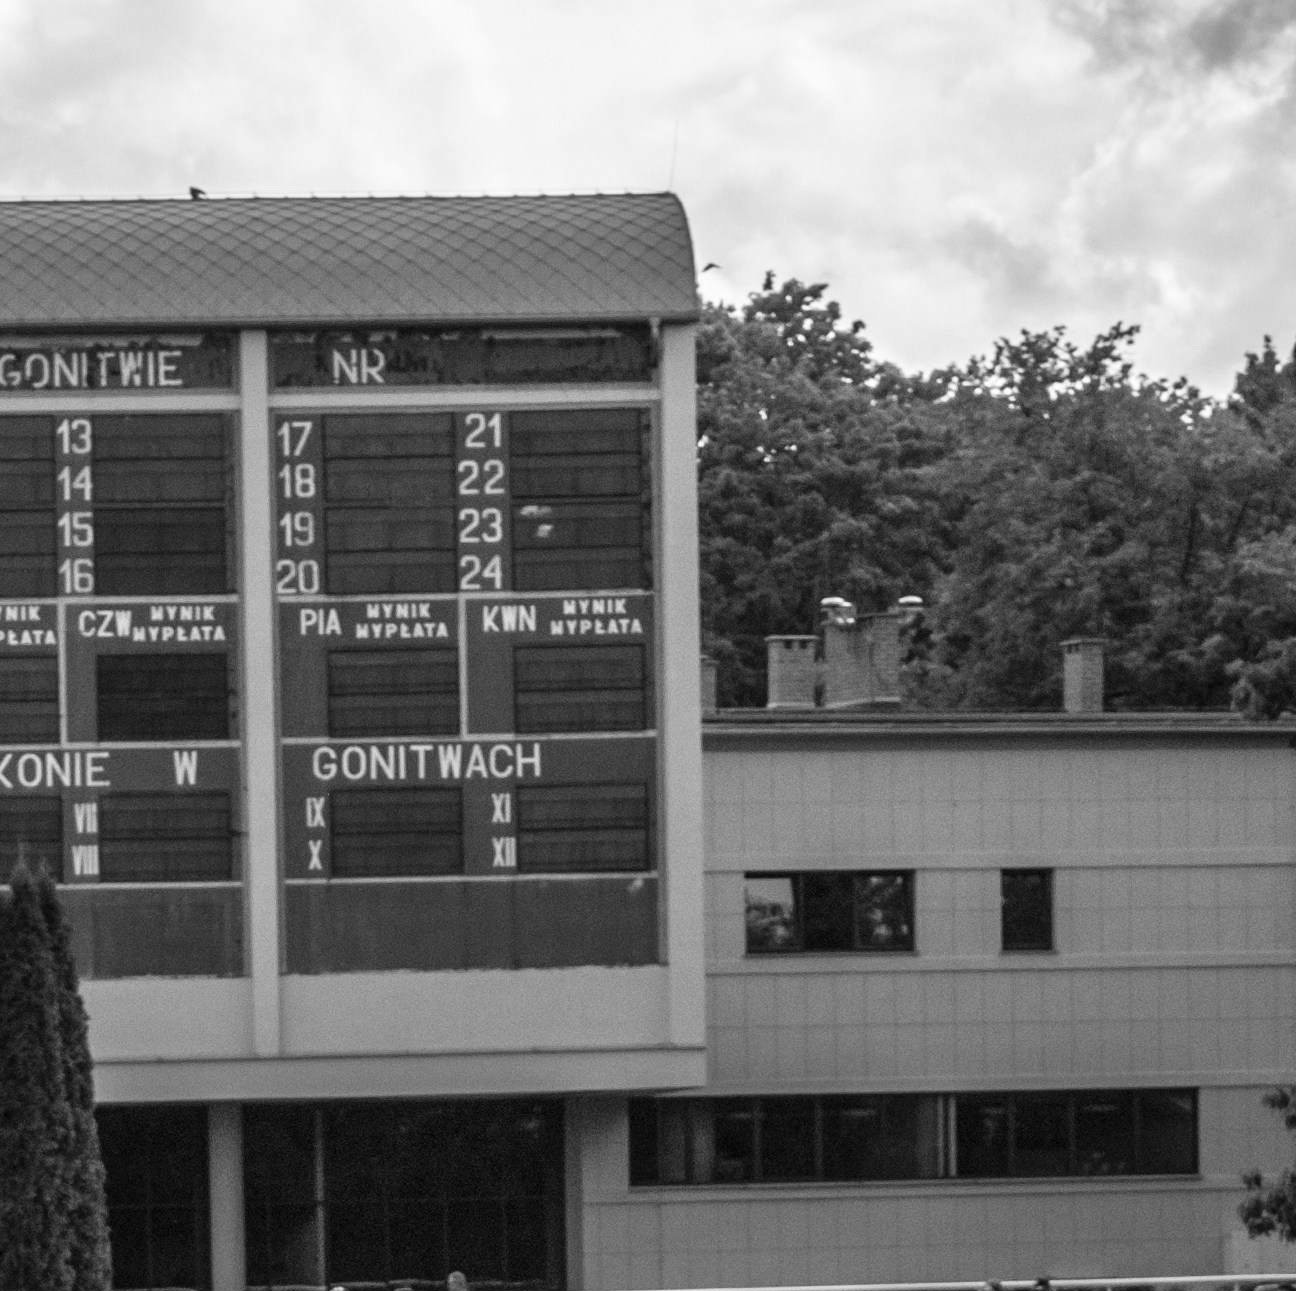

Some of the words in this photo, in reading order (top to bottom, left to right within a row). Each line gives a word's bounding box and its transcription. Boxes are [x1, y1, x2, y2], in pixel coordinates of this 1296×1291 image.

[332, 348, 386, 384] NR
[56, 418, 92, 454] 13
[278, 420, 313, 456] 17
[464, 412, 501, 448] 21
[56, 465, 93, 501] 14
[279, 463, 316, 499] 18
[458, 459, 505, 495] 22
[57, 511, 94, 547] 15
[279, 512, 315, 547] 19
[459, 508, 503, 543] 23
[58, 558, 95, 594] 16
[276, 558, 320, 594] 20
[459, 554, 502, 590] 24
[78, 610, 132, 638] CZW
[150, 605, 215, 621] WYNIK
[300, 608, 342, 635] PIA
[366, 602, 431, 619] WYNIK
[482, 605, 537, 632] KWN
[563, 599, 628, 615] WYNIK
[132, 625, 226, 642] WYPŁATA
[355, 622, 449, 639] WYPŁATA
[550, 618, 644, 635] WYPŁATA
[173, 750, 198, 786] W
[312, 742, 542, 780] GONITWACH
[73, 802, 98, 834] VII
[306, 796, 325, 828] IX
[491, 793, 511, 824] XI
[308, 839, 323, 870] X
[491, 836, 517, 868] XII
